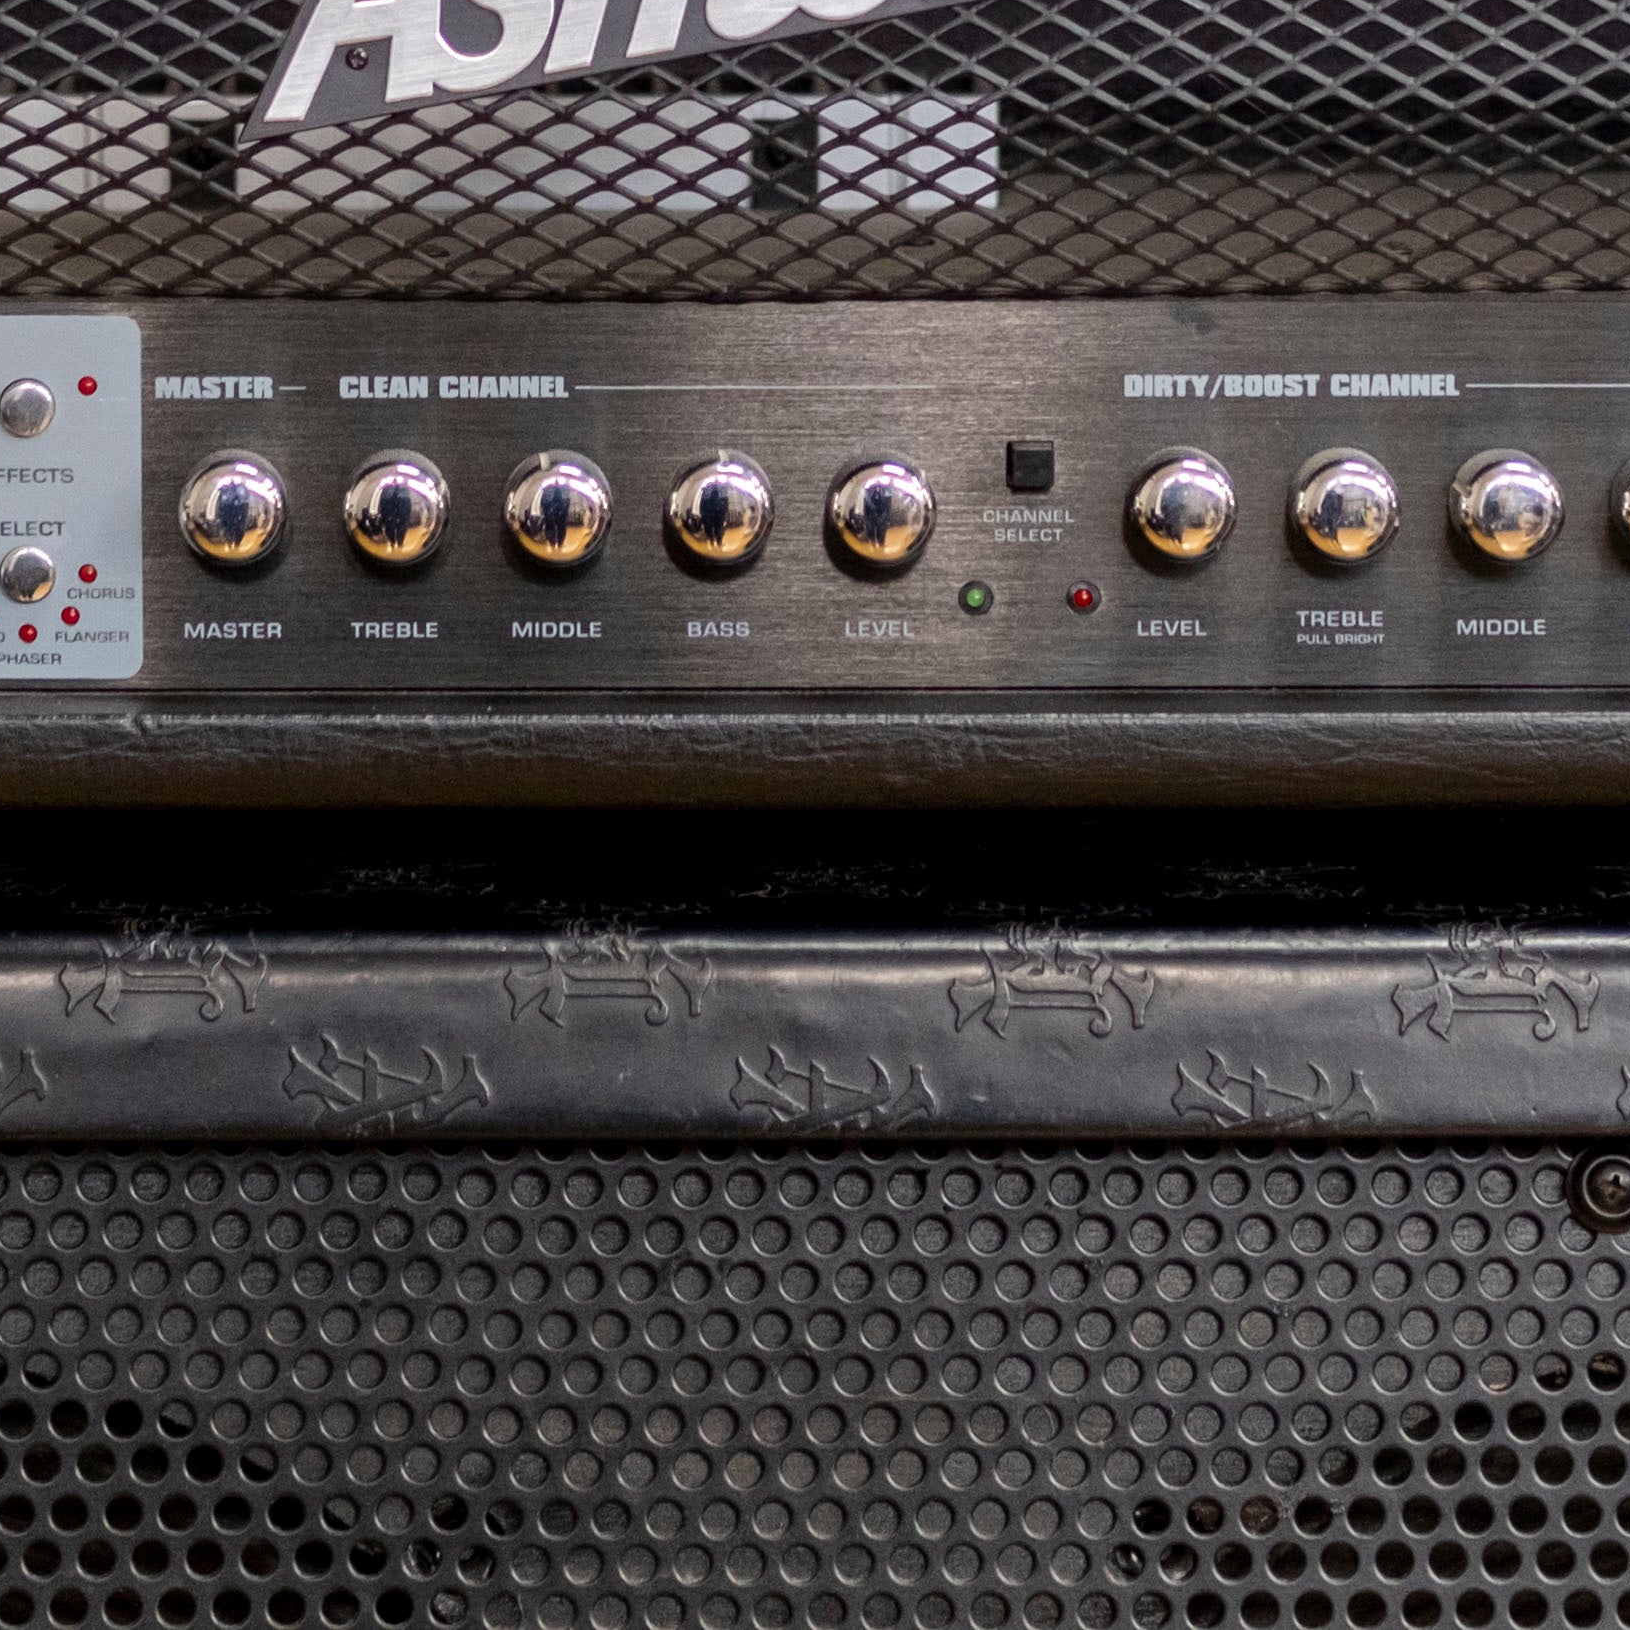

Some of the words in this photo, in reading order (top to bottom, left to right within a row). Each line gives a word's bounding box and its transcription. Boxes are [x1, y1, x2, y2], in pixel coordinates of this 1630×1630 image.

[154, 376, 273, 399] MASTER
[339, 376, 429, 399] CLEAN
[438, 375, 569, 399] CHANNEL
[1123, 373, 1321, 400] DIRTY/BOOST
[1330, 374, 1460, 398] CHANNEL
[982, 508, 1074, 525] CHANNEL
[994, 527, 1064, 543] SELECT
[66, 587, 136, 600] CHORUS
[1296, 610, 1384, 628] TREBLE
[1456, 618, 1547, 636] MIDDLE
[54, 631, 130, 643] FLANGER
[183, 621, 282, 639] MASTER
[351, 621, 439, 639] TREBLE
[511, 621, 602, 639] MIDDLE
[686, 621, 750, 639] BASS
[844, 620, 915, 638] LEVEL
[1136, 620, 1207, 637] LEVEL
[1296, 633, 1331, 645] PULL
[1335, 633, 1385, 645] BRIGHT
